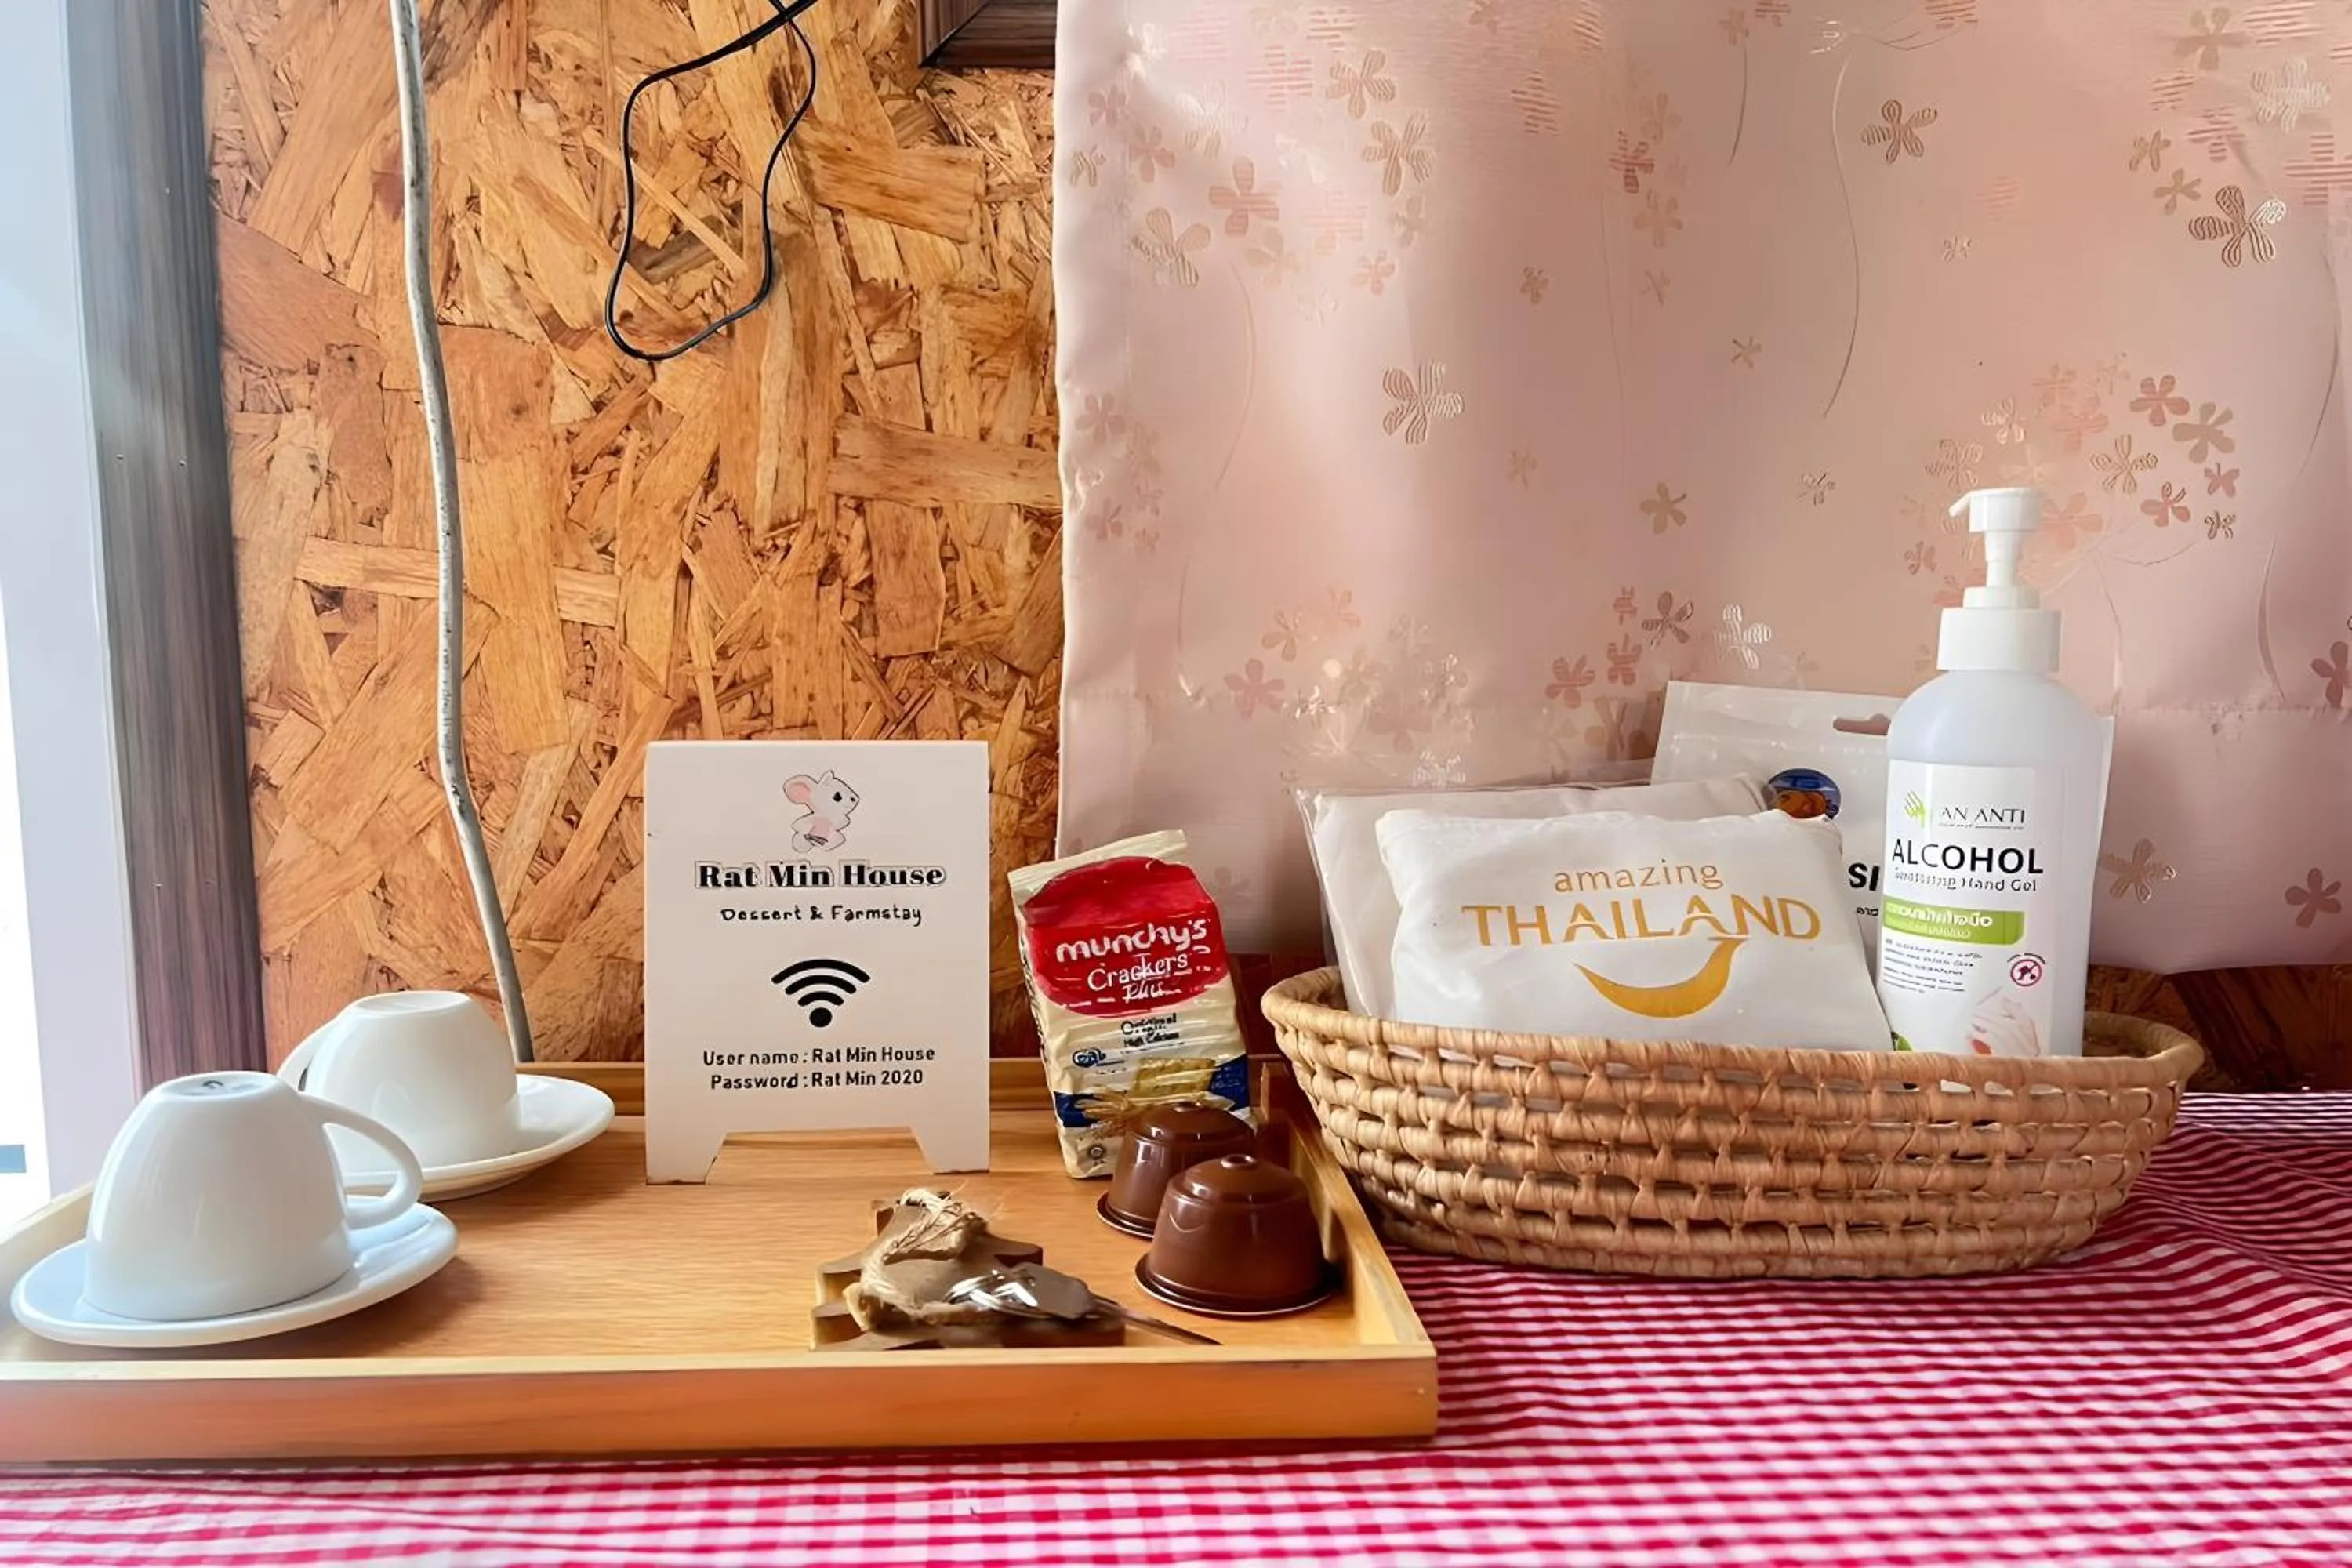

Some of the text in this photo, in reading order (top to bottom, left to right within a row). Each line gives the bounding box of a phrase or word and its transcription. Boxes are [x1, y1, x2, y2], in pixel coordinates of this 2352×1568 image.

[1974, 808, 2025, 825] ANTI
[1891, 838, 2044, 875] ALCOHOL
[697, 862, 946, 888] Rat Min House
[1554, 858, 1726, 893] amazing
[1960, 877, 2005, 891] Hand
[720, 903, 923, 927] Dessert & Farmstay
[1461, 894, 1823, 946] THAILAND
[1055, 918, 1209, 963] munchy's
[1087, 953, 1189, 991] Crackers
[702, 1050, 746, 1066] User
[811, 1047, 842, 1064] Rat
[846, 1047, 877, 1062] Min
[880, 1046, 936, 1062] House
[811, 1071, 842, 1087] Rat
[845, 1070, 877, 1087] Min
[880, 1069, 924, 1086] 2020
